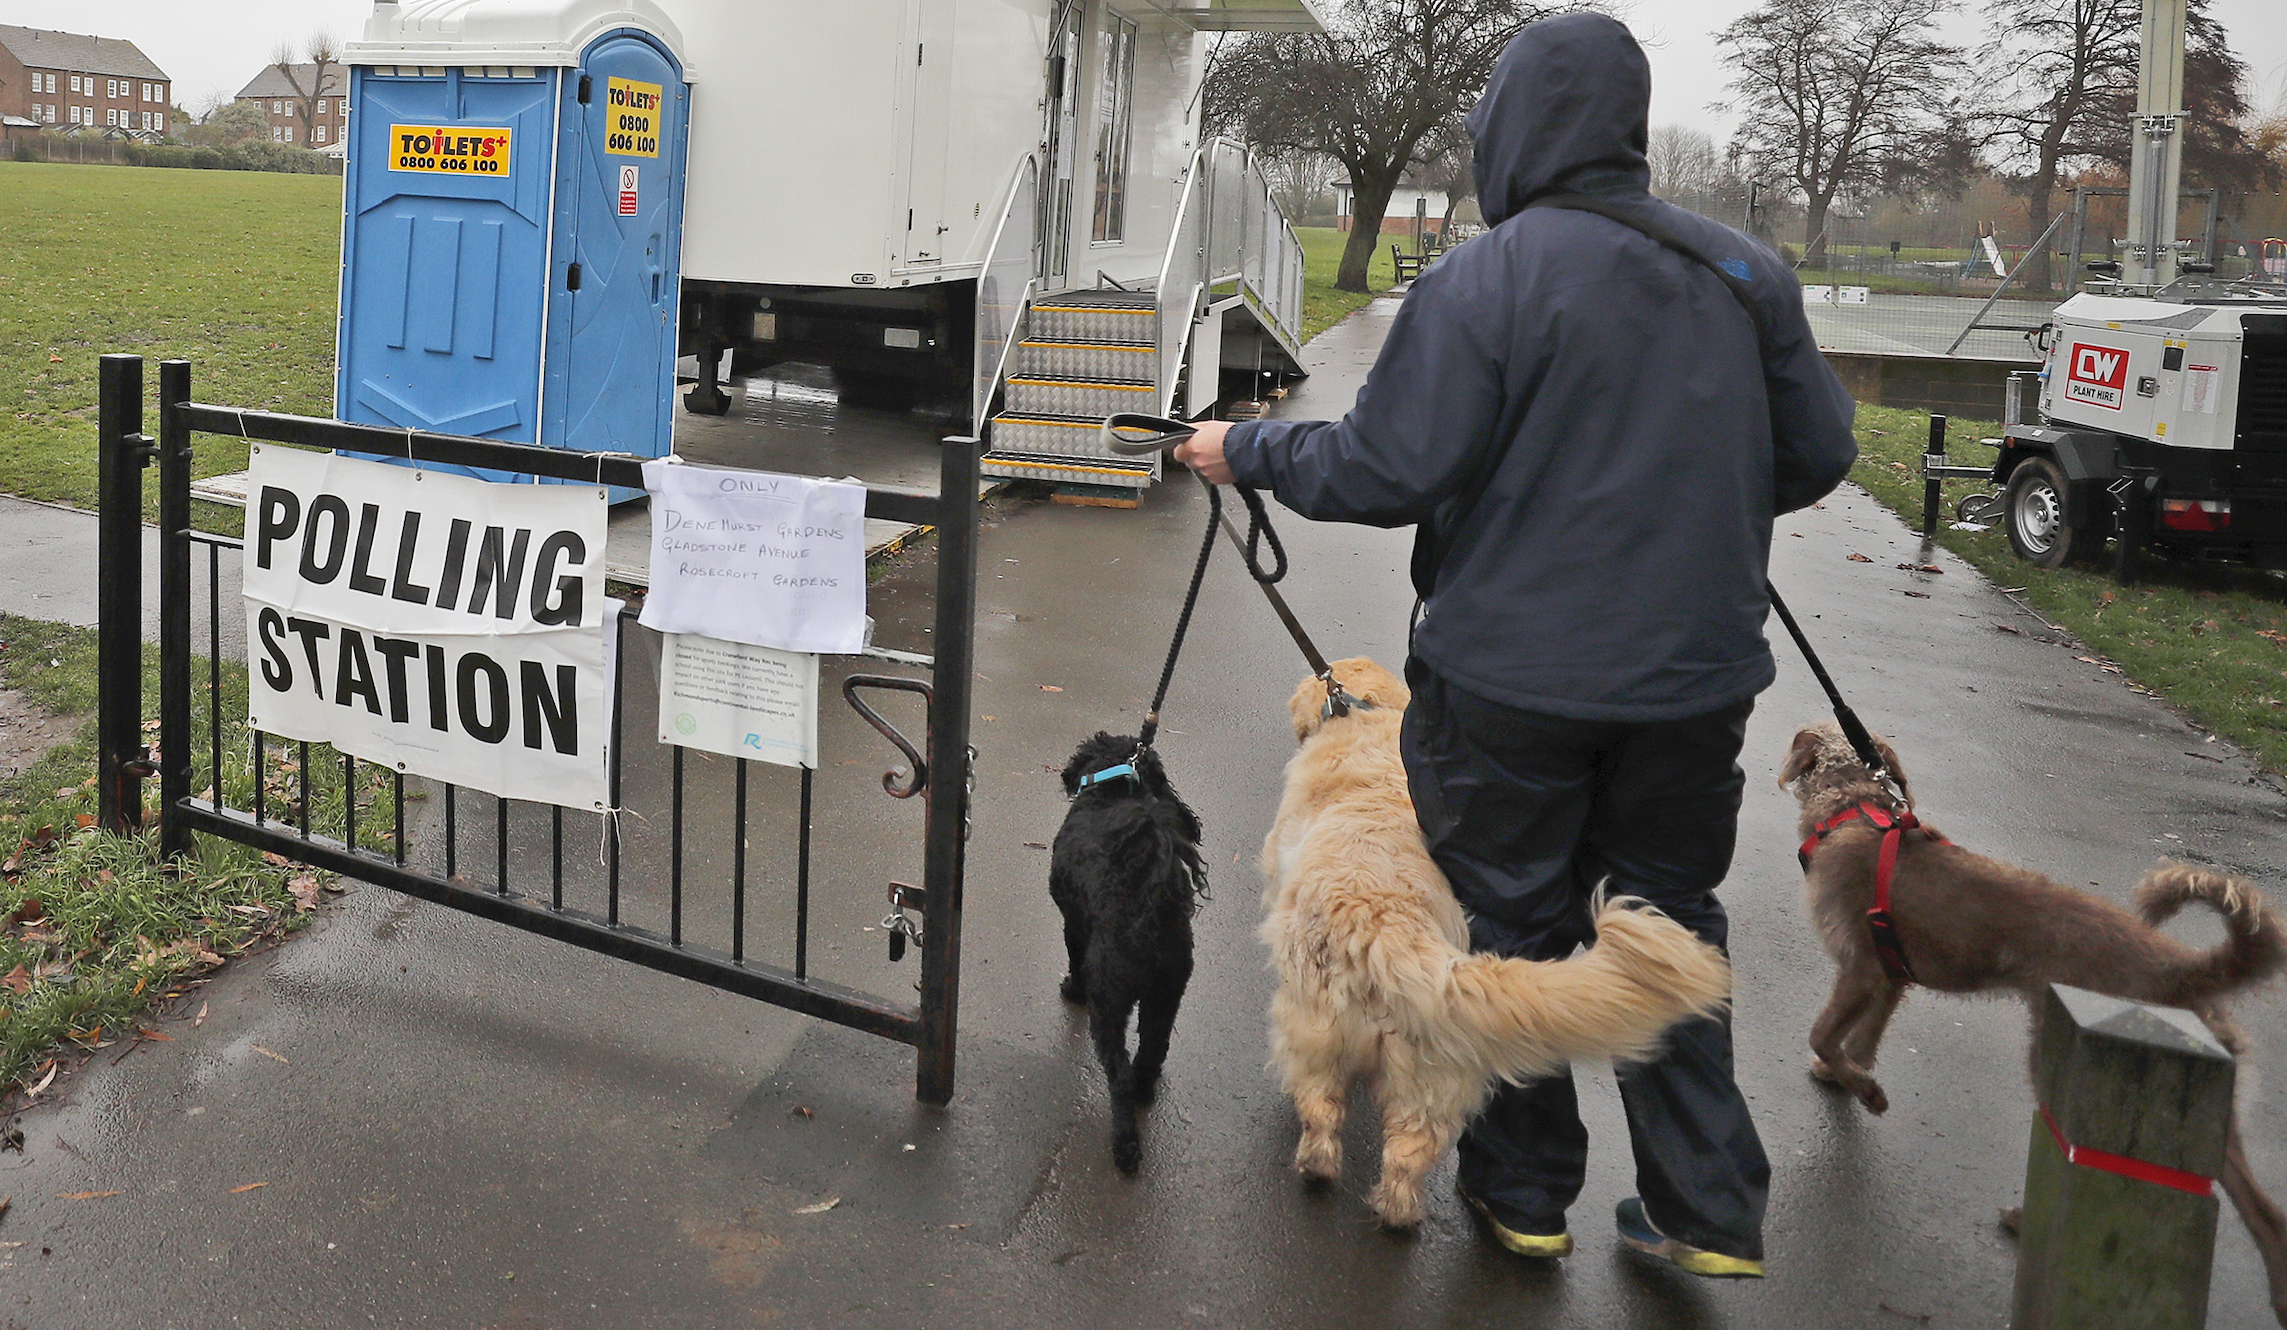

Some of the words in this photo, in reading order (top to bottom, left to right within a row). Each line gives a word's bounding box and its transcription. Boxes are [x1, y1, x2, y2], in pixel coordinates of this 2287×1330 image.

[620, 114, 649, 133] 0800
[609, 133, 632, 150] 606
[400, 156, 435, 169] 0800
[440, 158, 467, 170] 606
[2076, 348, 2121, 383] CW
[2073, 385, 2096, 399] PLANT
[2096, 389, 2115, 402] HIRE
[718, 477, 780, 493] ONLY
[777, 523, 845, 540] GARDENS
[257, 485, 587, 627] POLLING
[661, 537, 747, 553] GLADSTONE
[758, 544, 810, 559] AVENUE
[679, 562, 759, 580] ROSECROFT
[772, 574, 838, 588] GARDENS
[258, 606, 578, 757] STATION
